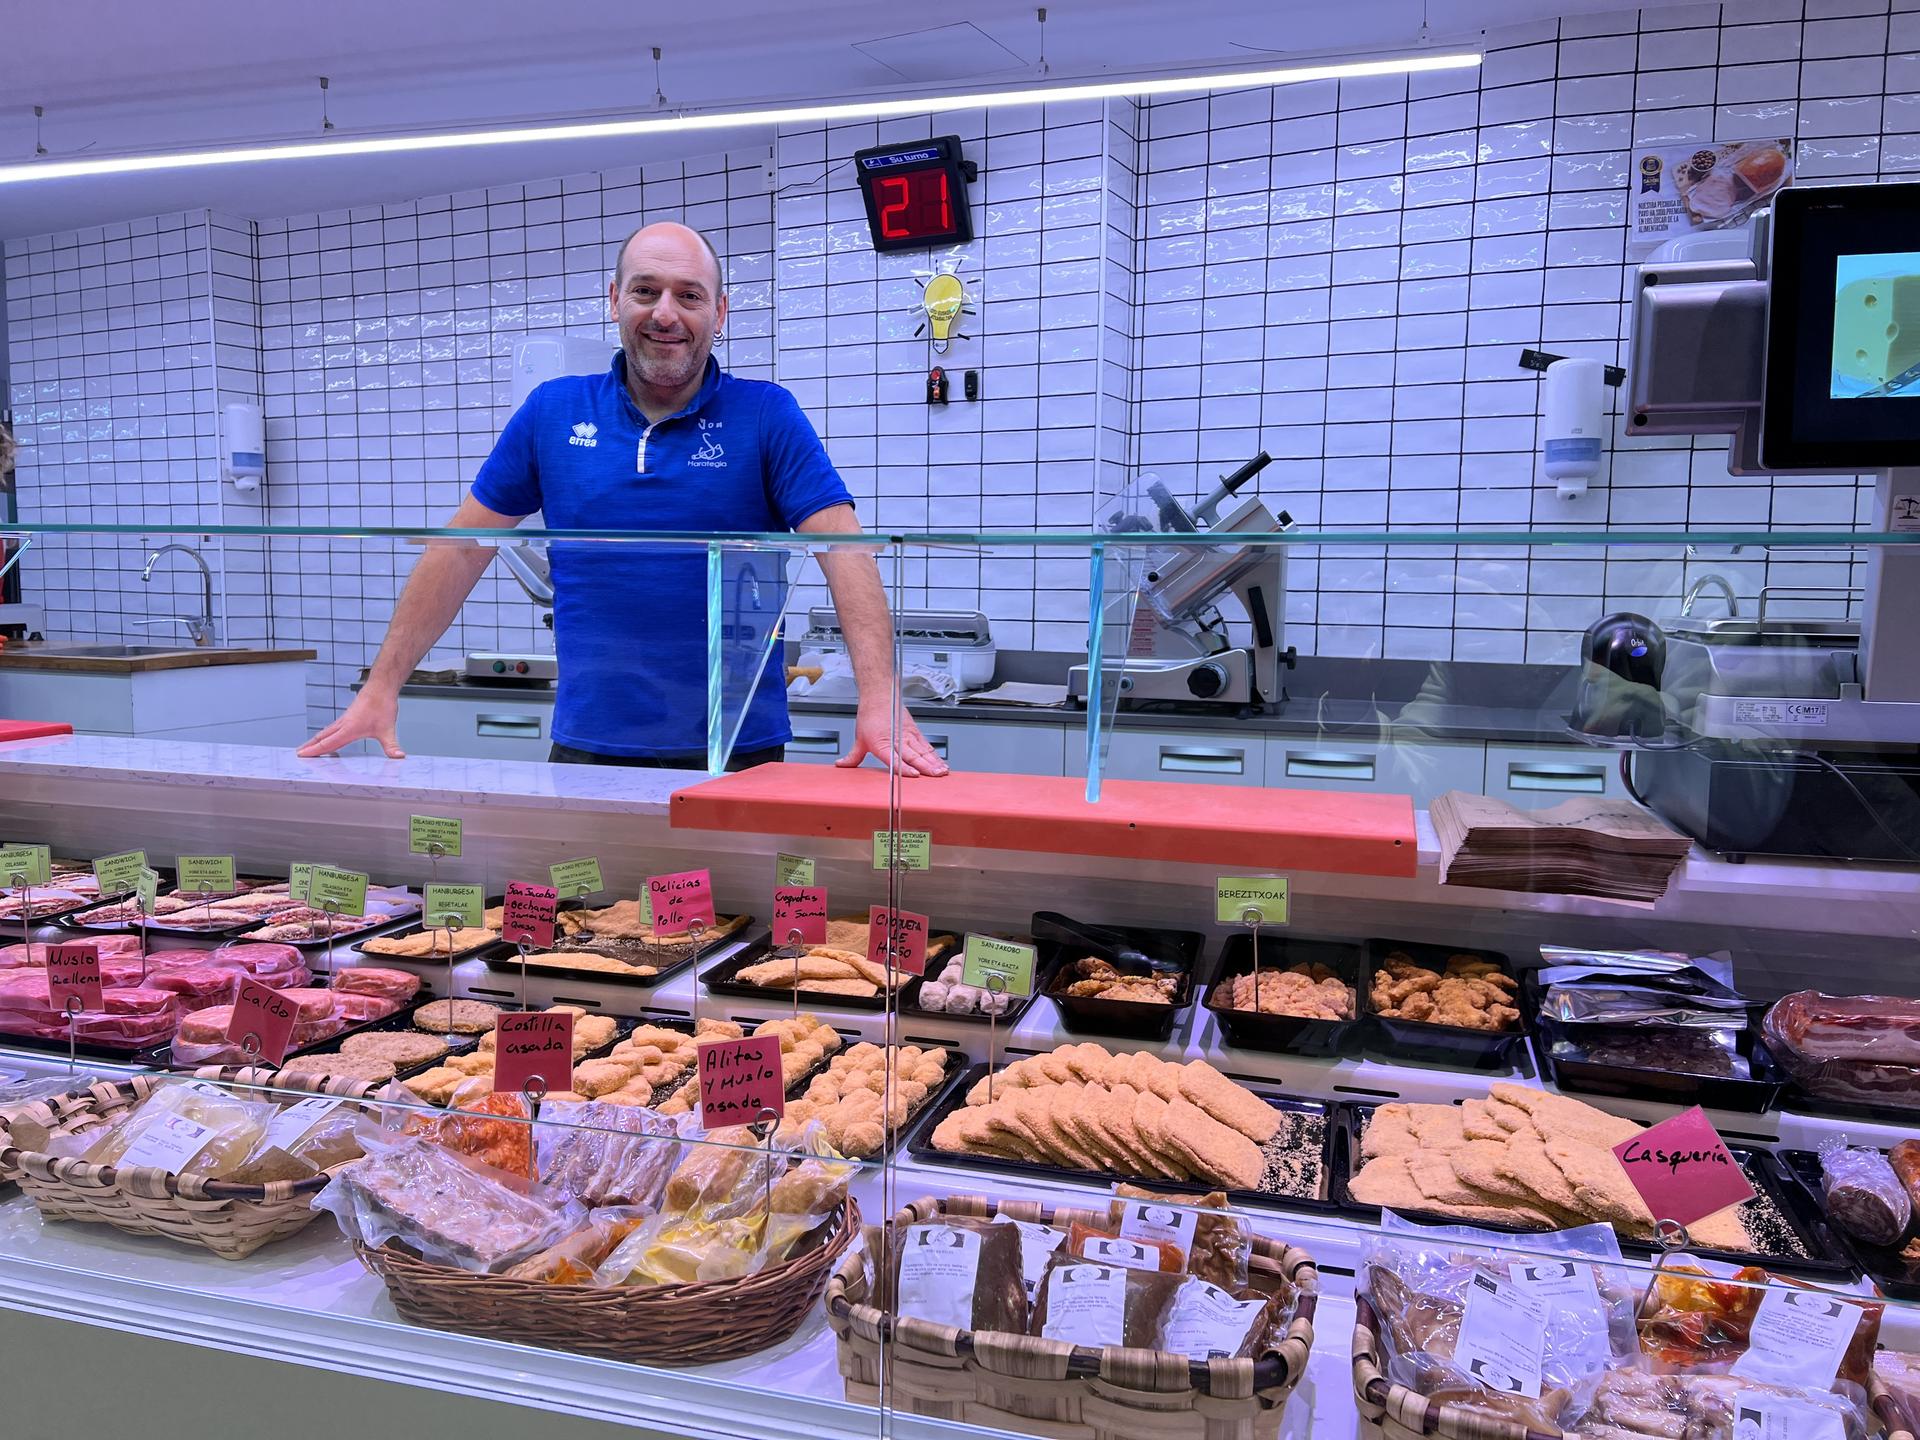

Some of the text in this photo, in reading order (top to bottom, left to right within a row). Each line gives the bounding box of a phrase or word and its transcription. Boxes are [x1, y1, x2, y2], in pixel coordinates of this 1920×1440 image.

[889, 152, 929, 164] Su turno
[881, 173, 948, 238] 21
[1638, 201, 1657, 209] NUESTRA
[1657, 200, 1676, 208] PECHUGA
[1638, 209, 1649, 217] PAVO
[104, 855, 136, 867] SANDWICH
[318, 870, 360, 882] HANBURGESA
[507, 883, 523, 896] San
[651, 879, 701, 893] Delicias
[668, 895, 684, 906] de
[1218, 889, 1286, 900] BEREZITXOAK
[657, 911, 684, 927] Pollo
[980, 940, 1021, 954] SAN JAKOBO
[991, 959, 1001, 967] ETA
[241, 986, 290, 1019] Caldo
[501, 1014, 566, 1033] Costilla
[505, 1038, 565, 1055] asada
[706, 1049, 763, 1072] Alitas
[705, 1095, 763, 1114] asada
[1623, 1141, 1729, 1176] Casquería
